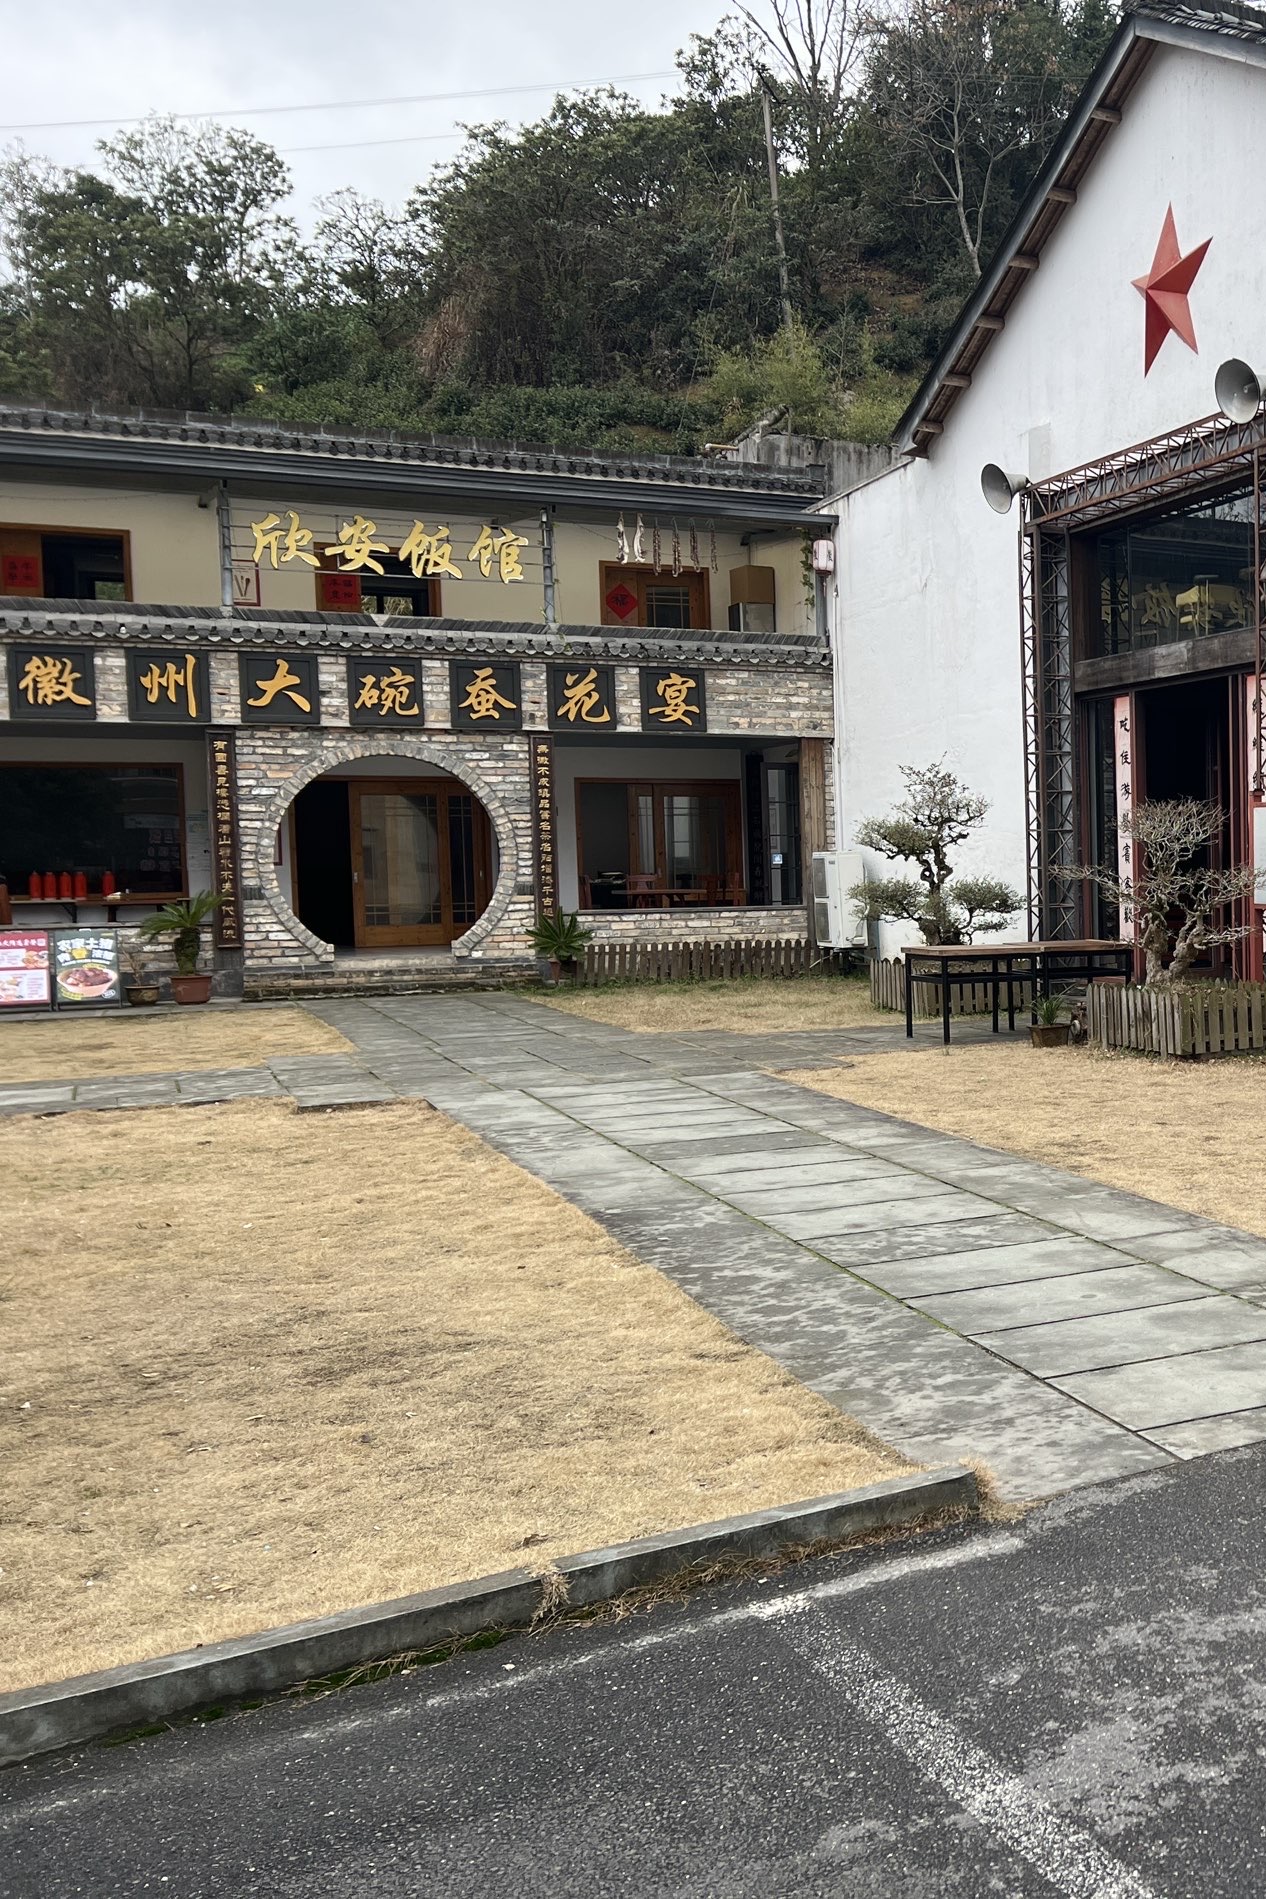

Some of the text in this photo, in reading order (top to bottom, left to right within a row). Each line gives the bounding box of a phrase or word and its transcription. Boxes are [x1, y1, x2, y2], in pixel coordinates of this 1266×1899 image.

[251, 510, 529, 584] 欣安饭馆
[18, 654, 700, 726] 徽州大碗蚕花宴
